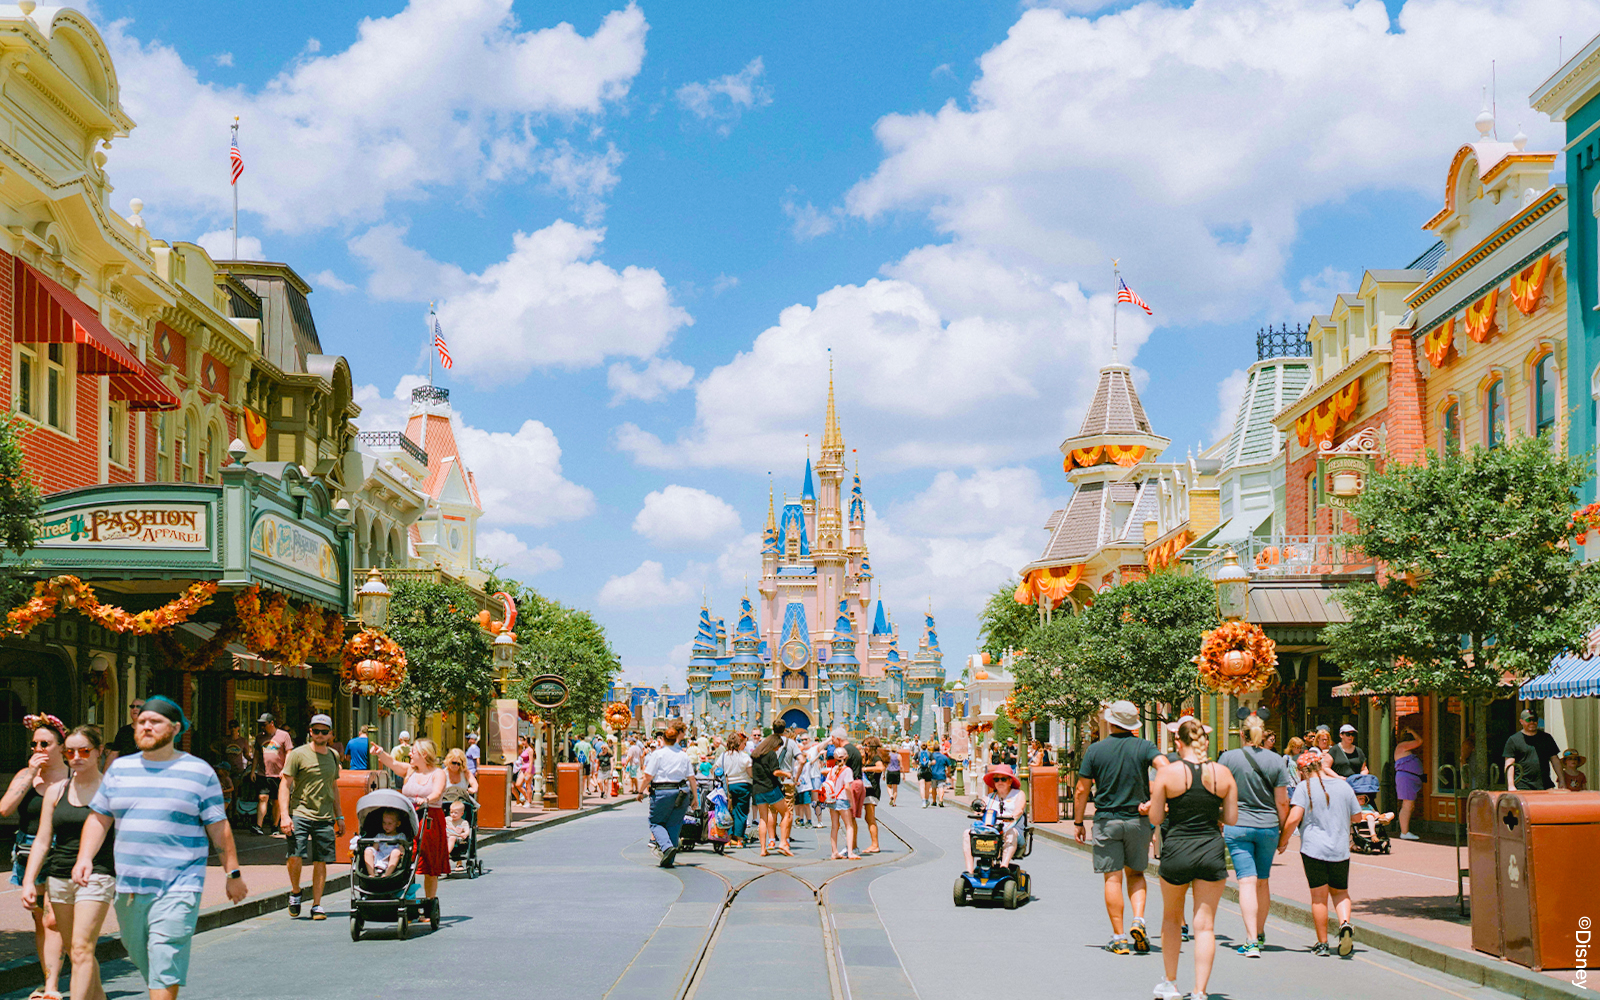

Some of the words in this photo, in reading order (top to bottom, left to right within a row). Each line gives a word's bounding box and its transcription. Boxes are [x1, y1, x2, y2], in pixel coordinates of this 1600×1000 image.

[30, 517, 73, 539] Street
[84, 509, 198, 542] FASHION
[138, 527, 202, 543] APPAREL
[786, 644, 806, 666] 50
[491, 711, 515, 738] 50
